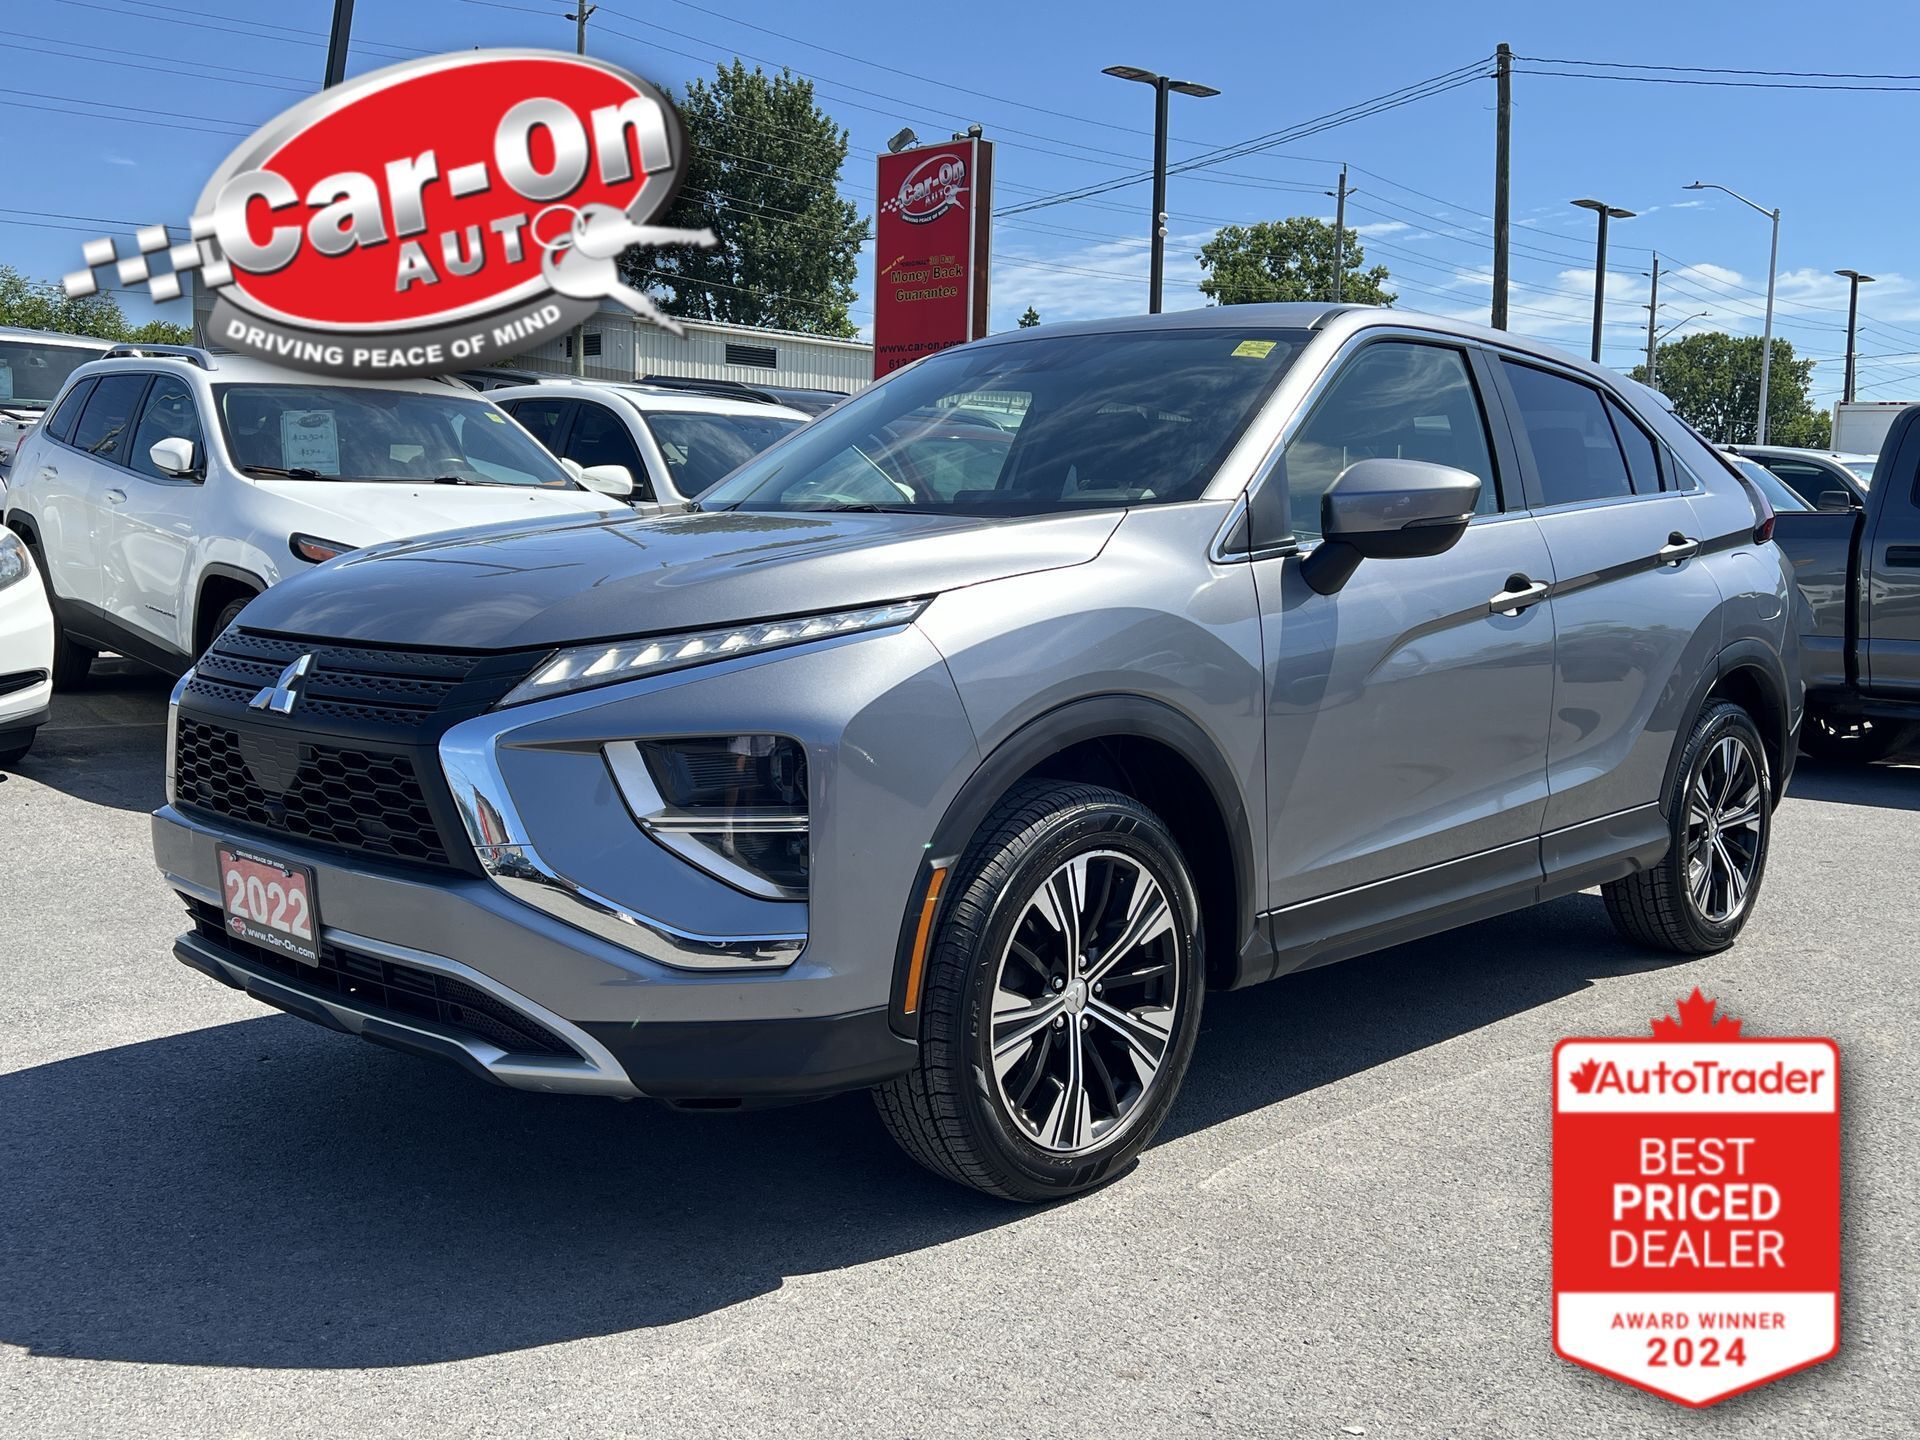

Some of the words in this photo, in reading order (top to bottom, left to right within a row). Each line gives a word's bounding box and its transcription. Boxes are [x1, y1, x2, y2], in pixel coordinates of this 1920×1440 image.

[901, 160, 965, 206] Car-On
[891, 269, 930, 284] Money
[933, 264, 963, 280] Back
[896, 285, 958, 302] Guarantee
[226, 869, 312, 941] 2022
[247, 928, 316, 960] www.Car-On.com
